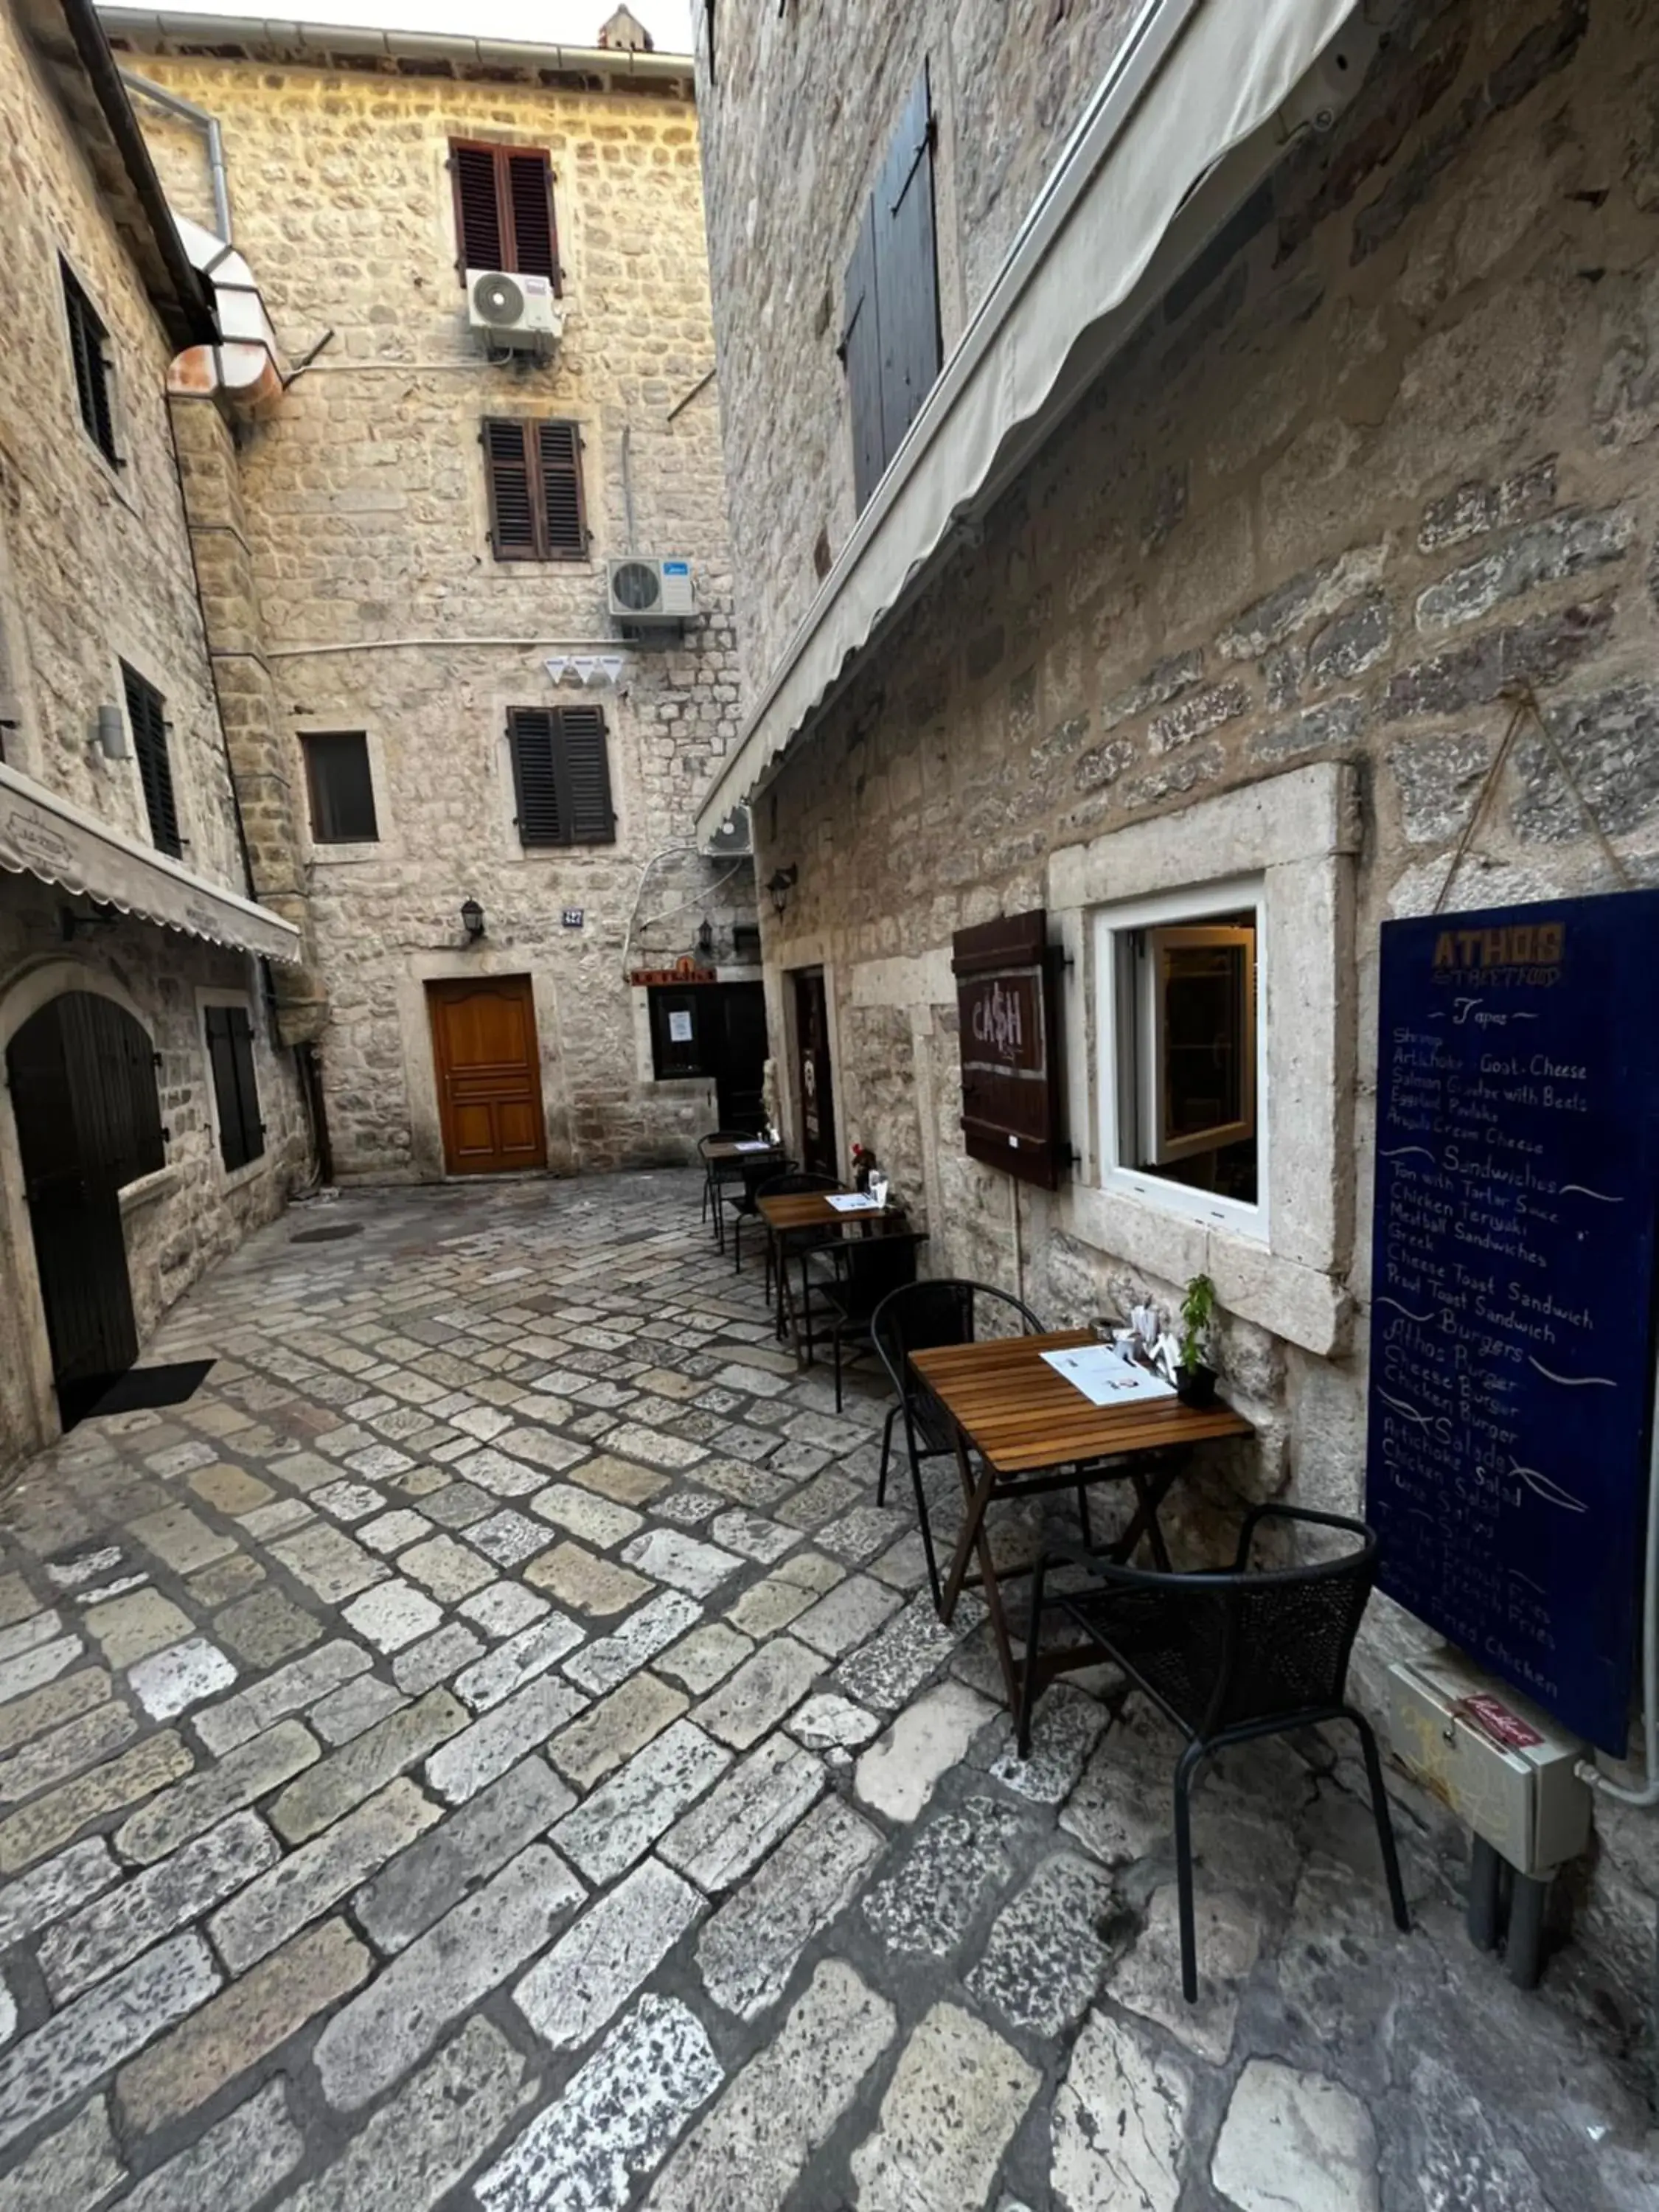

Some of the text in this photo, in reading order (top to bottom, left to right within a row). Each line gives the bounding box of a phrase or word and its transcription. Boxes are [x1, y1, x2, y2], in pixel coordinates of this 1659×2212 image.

[1433, 922, 1565, 967] ATHOS
[1530, 1054, 1587, 1079] Cheese
[1503, 1085, 1539, 1107] with
[1485, 1127, 1544, 1155] Cheese
[1442, 1144, 1557, 1194] Sandwiches
[1391, 1181, 1454, 1217] Chicken
[1388, 1221, 1434, 1252] Greek
[1387, 1242, 1595, 1330] Cheese Toast Sandwich
[1427, 1278, 1470, 1310] Toast
[1474, 1295, 1556, 1345] Sandwich
[1383, 1318, 1520, 1392] Athos Burger
[1436, 1307, 1524, 1363] Burgers
[1385, 1345, 1521, 1418] Cheese Burger
[1385, 1364, 1520, 1444] Chicken Burger
[1382, 1438, 1444, 1486] Chicken
[1384, 1416, 1522, 1508] Artichoke Salad
[1485, 1634, 1559, 1699] Chicken
